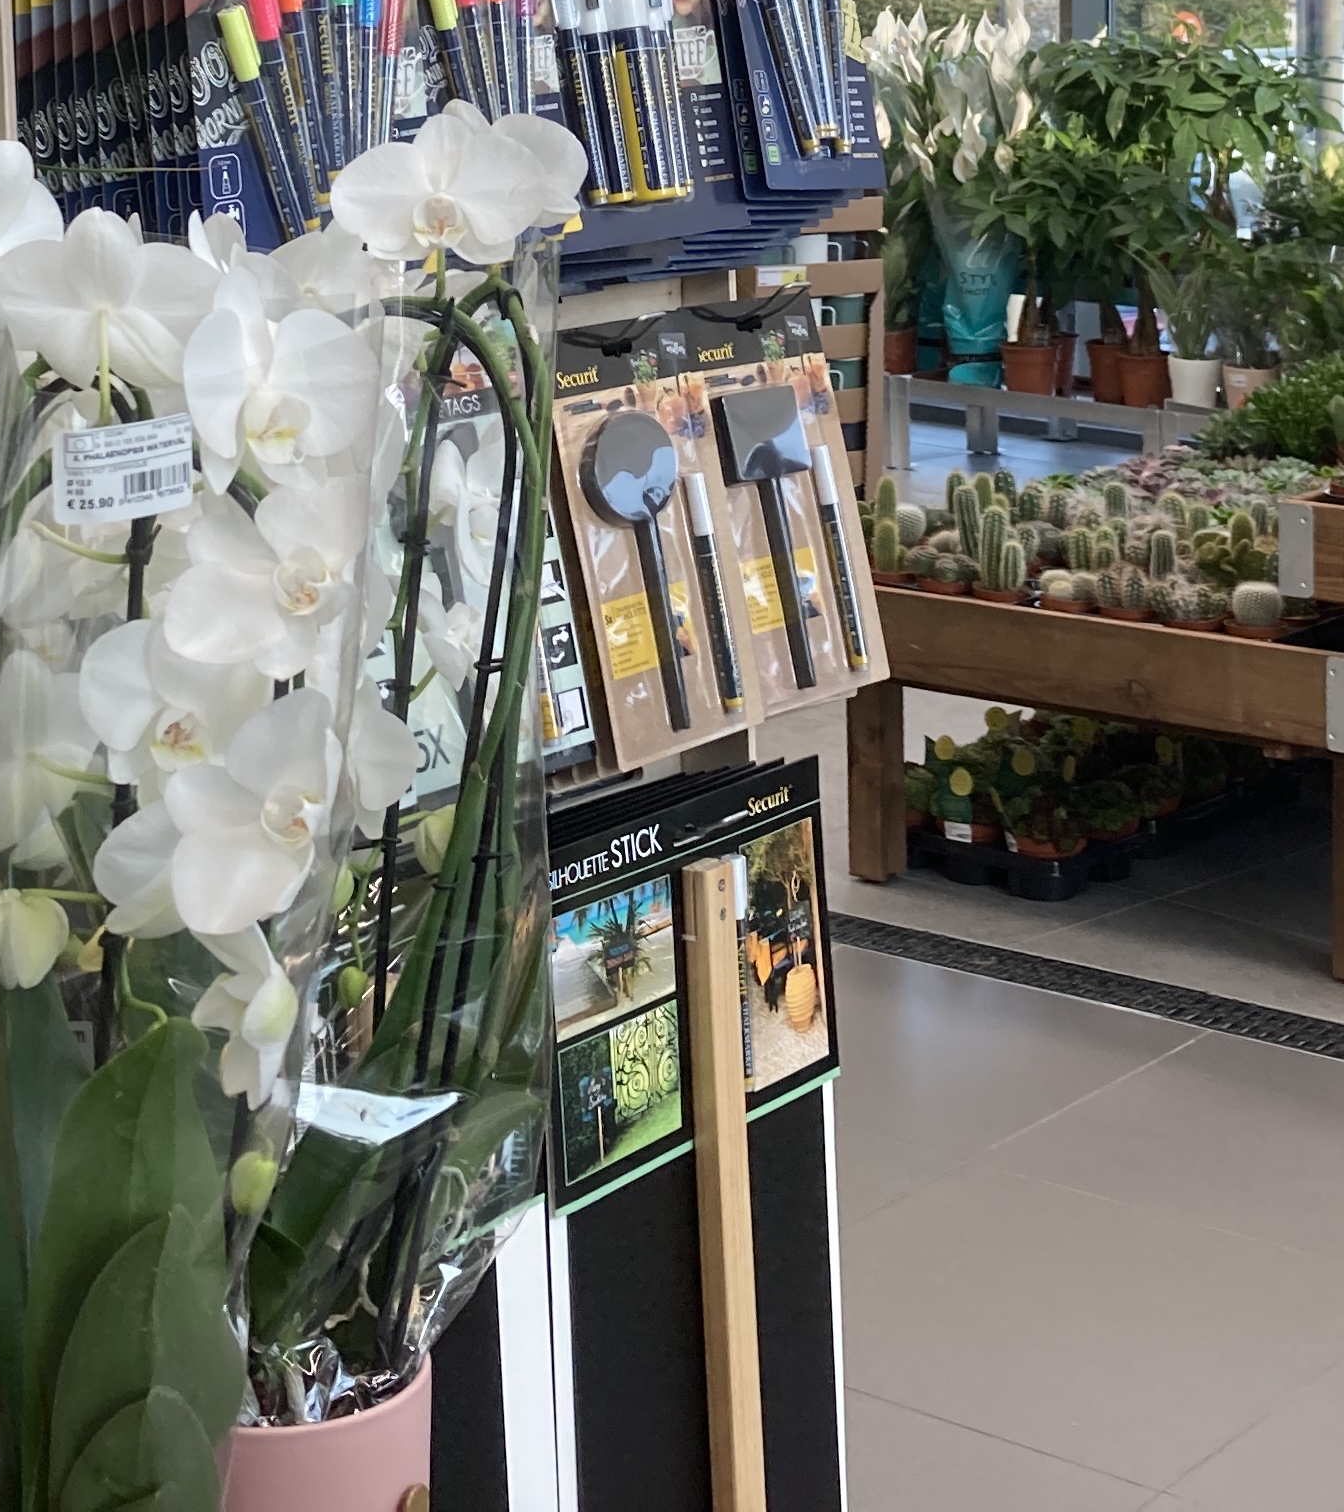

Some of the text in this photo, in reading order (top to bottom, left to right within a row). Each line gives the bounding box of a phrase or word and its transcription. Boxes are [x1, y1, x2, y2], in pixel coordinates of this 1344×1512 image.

[556, 365, 600, 390] Securit
[444, 393, 482, 417] TAGS
[747, 786, 791, 818] Securit
[610, 823, 664, 868] STICK
